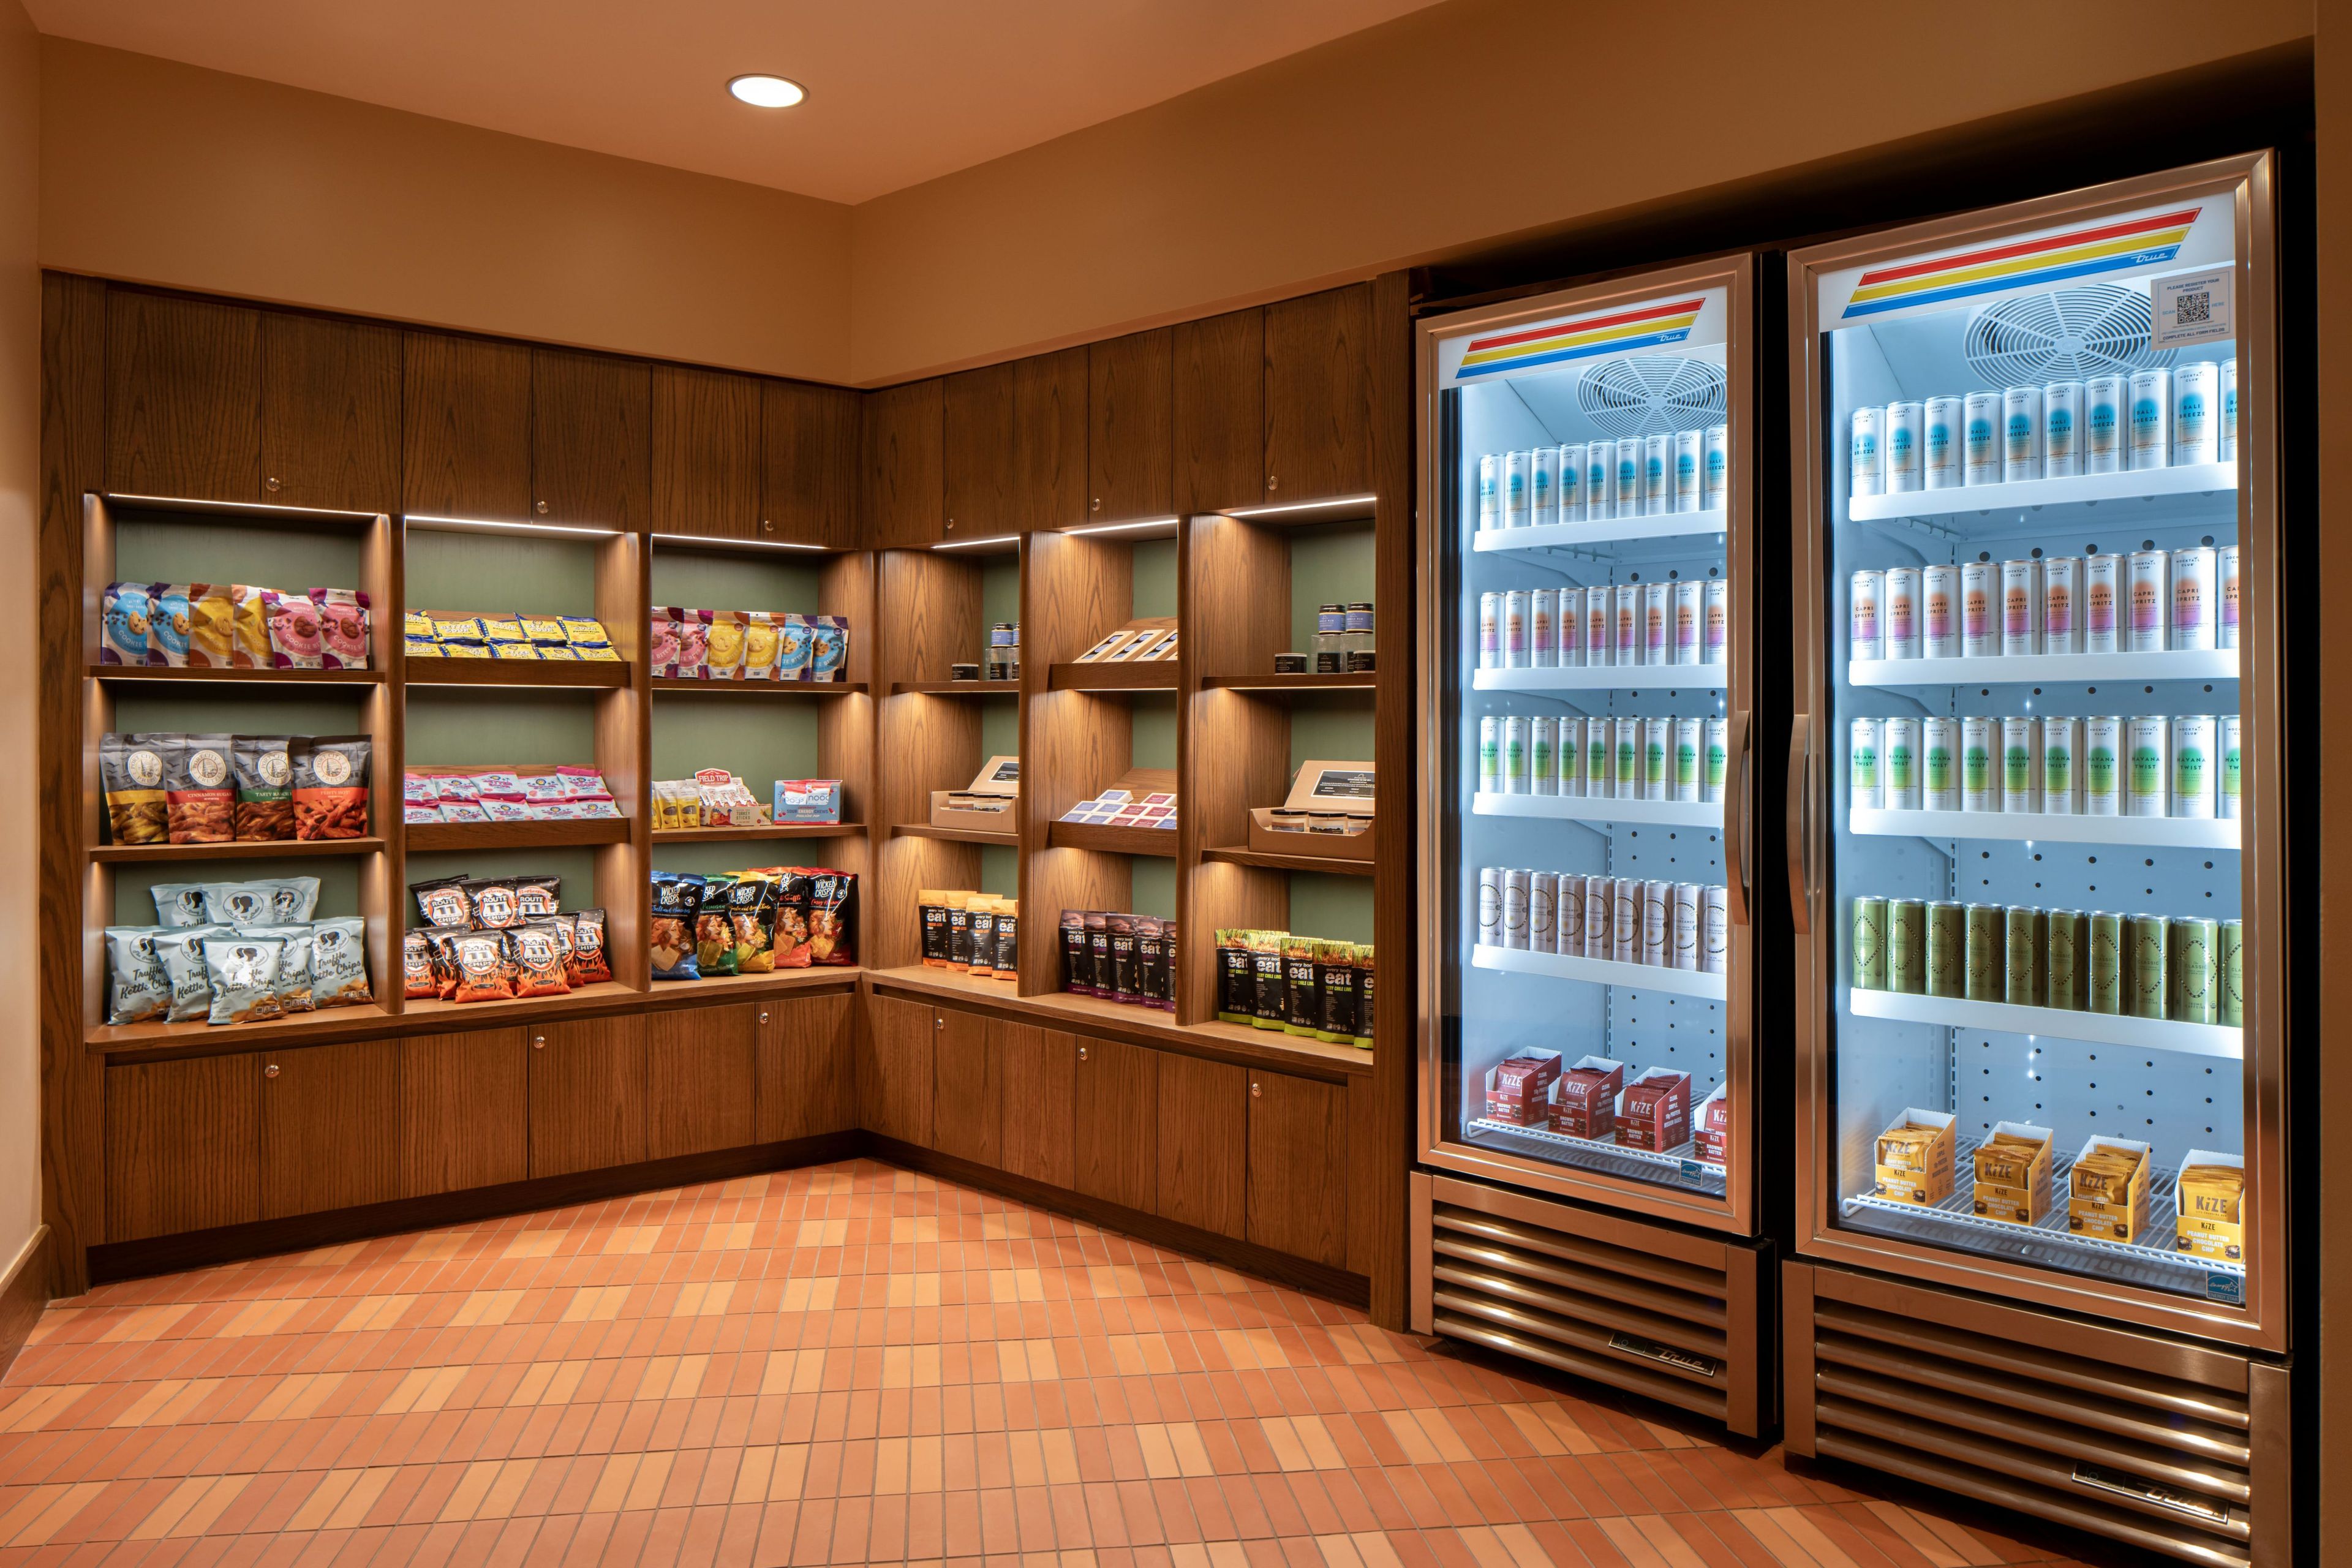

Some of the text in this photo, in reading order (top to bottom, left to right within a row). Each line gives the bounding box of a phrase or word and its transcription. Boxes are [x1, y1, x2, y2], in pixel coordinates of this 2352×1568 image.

[2131, 253, 2168, 263] true
[118, 630, 142, 647] COOKIE
[285, 633, 312, 649] COOKIE
[333, 635, 356, 650] COOKIE
[656, 646, 671, 659] BITES
[815, 880, 835, 889] WICKED
[662, 886, 680, 896] WICKED
[737, 886, 756, 897] WICKED
[815, 888, 833, 897] CRISPS
[661, 894, 679, 905] CRISPS
[736, 893, 753, 904] CRISPS
[436, 907, 456, 915] 11
[487, 904, 505, 913] 11
[927, 913, 946, 922] eat
[1114, 941, 1133, 951] eat
[1140, 944, 1161, 955] eat
[318, 952, 347, 970] Truffle
[336, 960, 361, 974] Chips
[1256, 961, 1281, 973] eat
[133, 965, 164, 981] Truffle
[279, 970, 306, 981] Chips
[1289, 967, 1314, 980] eat
[1325, 973, 1351, 986] eat
[178, 982, 204, 999] Kettle
[1502, 1074, 1521, 1086] KiZE
[1566, 1082, 1586, 1094] KiZE
[1630, 1101, 1652, 1114] KiZE
[1886, 1141, 1910, 1154] KiZE
[1985, 1163, 2011, 1179] KiZE
[2080, 1174, 2107, 1191] KiZE
[1988, 1202, 2014, 1212] CHOCOLATE
[2196, 1196, 2227, 1213] KiZE
[2084, 1217, 2112, 1226] CHOCOLATE
[2193, 1238, 2223, 1248] CHOCOLATE
